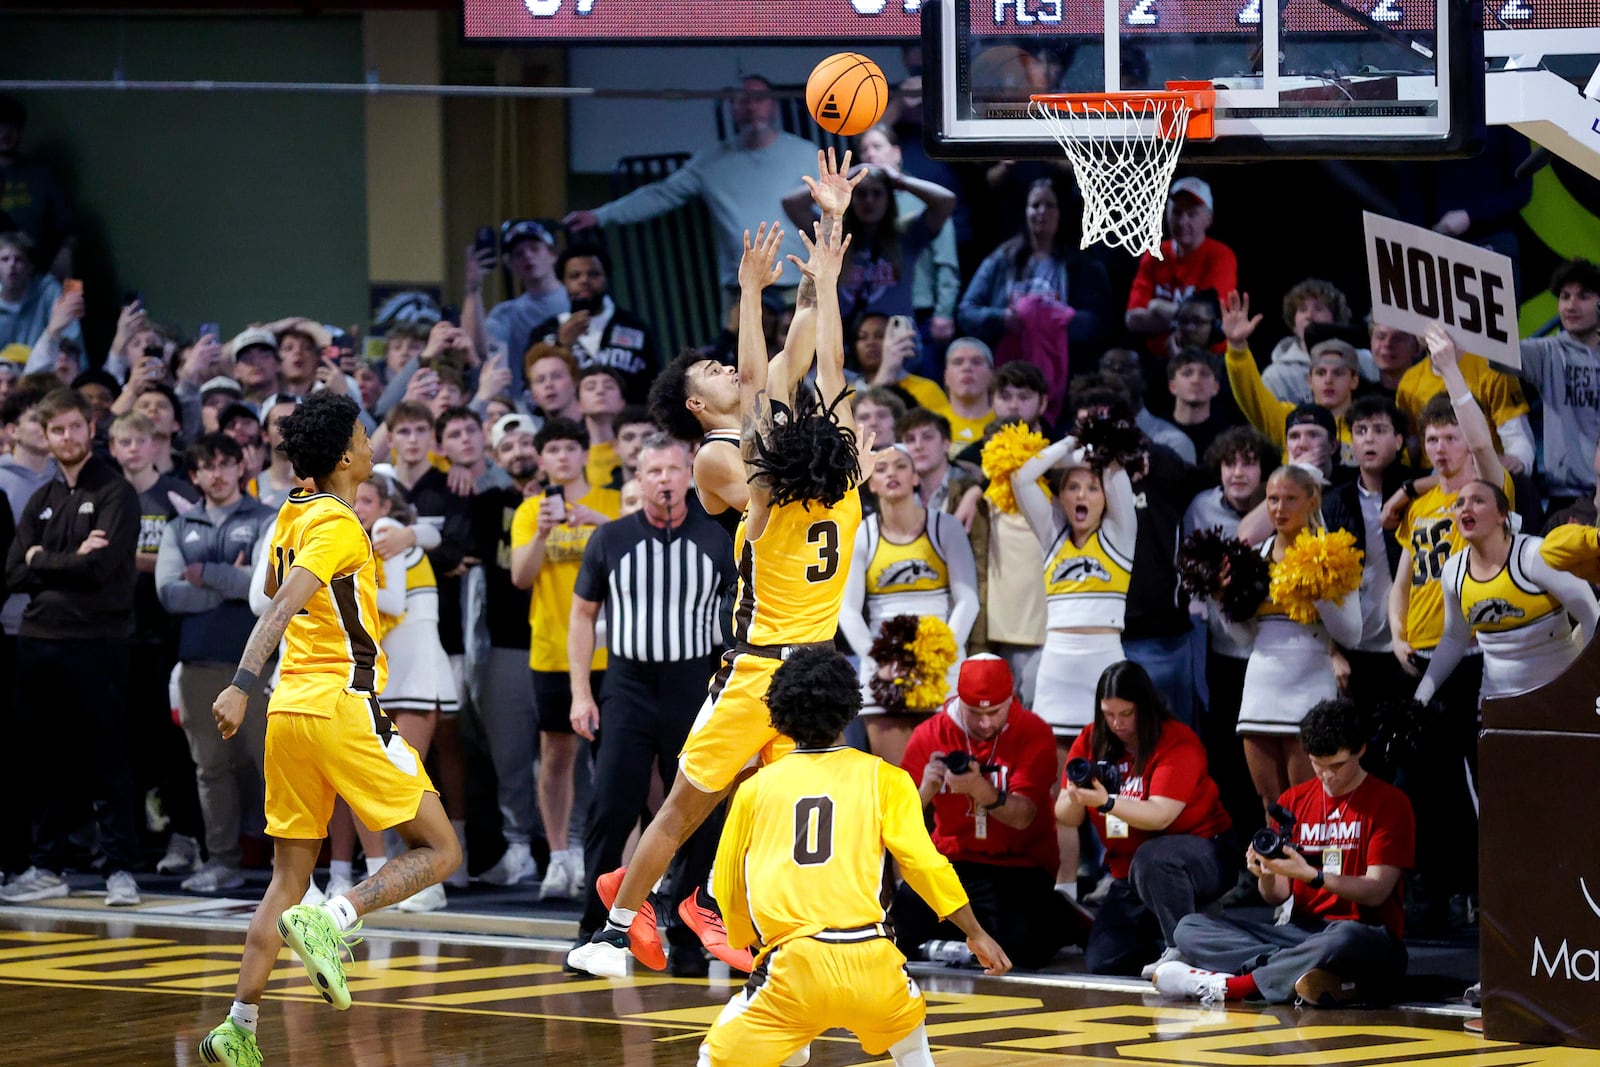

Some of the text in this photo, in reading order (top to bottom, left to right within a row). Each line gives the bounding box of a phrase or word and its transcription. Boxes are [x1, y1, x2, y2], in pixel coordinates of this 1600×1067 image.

[1375, 237, 1508, 344] NOISE
[805, 520, 840, 584] 3
[793, 795, 834, 867] 0
[1300, 821, 1361, 842] MIAMI
